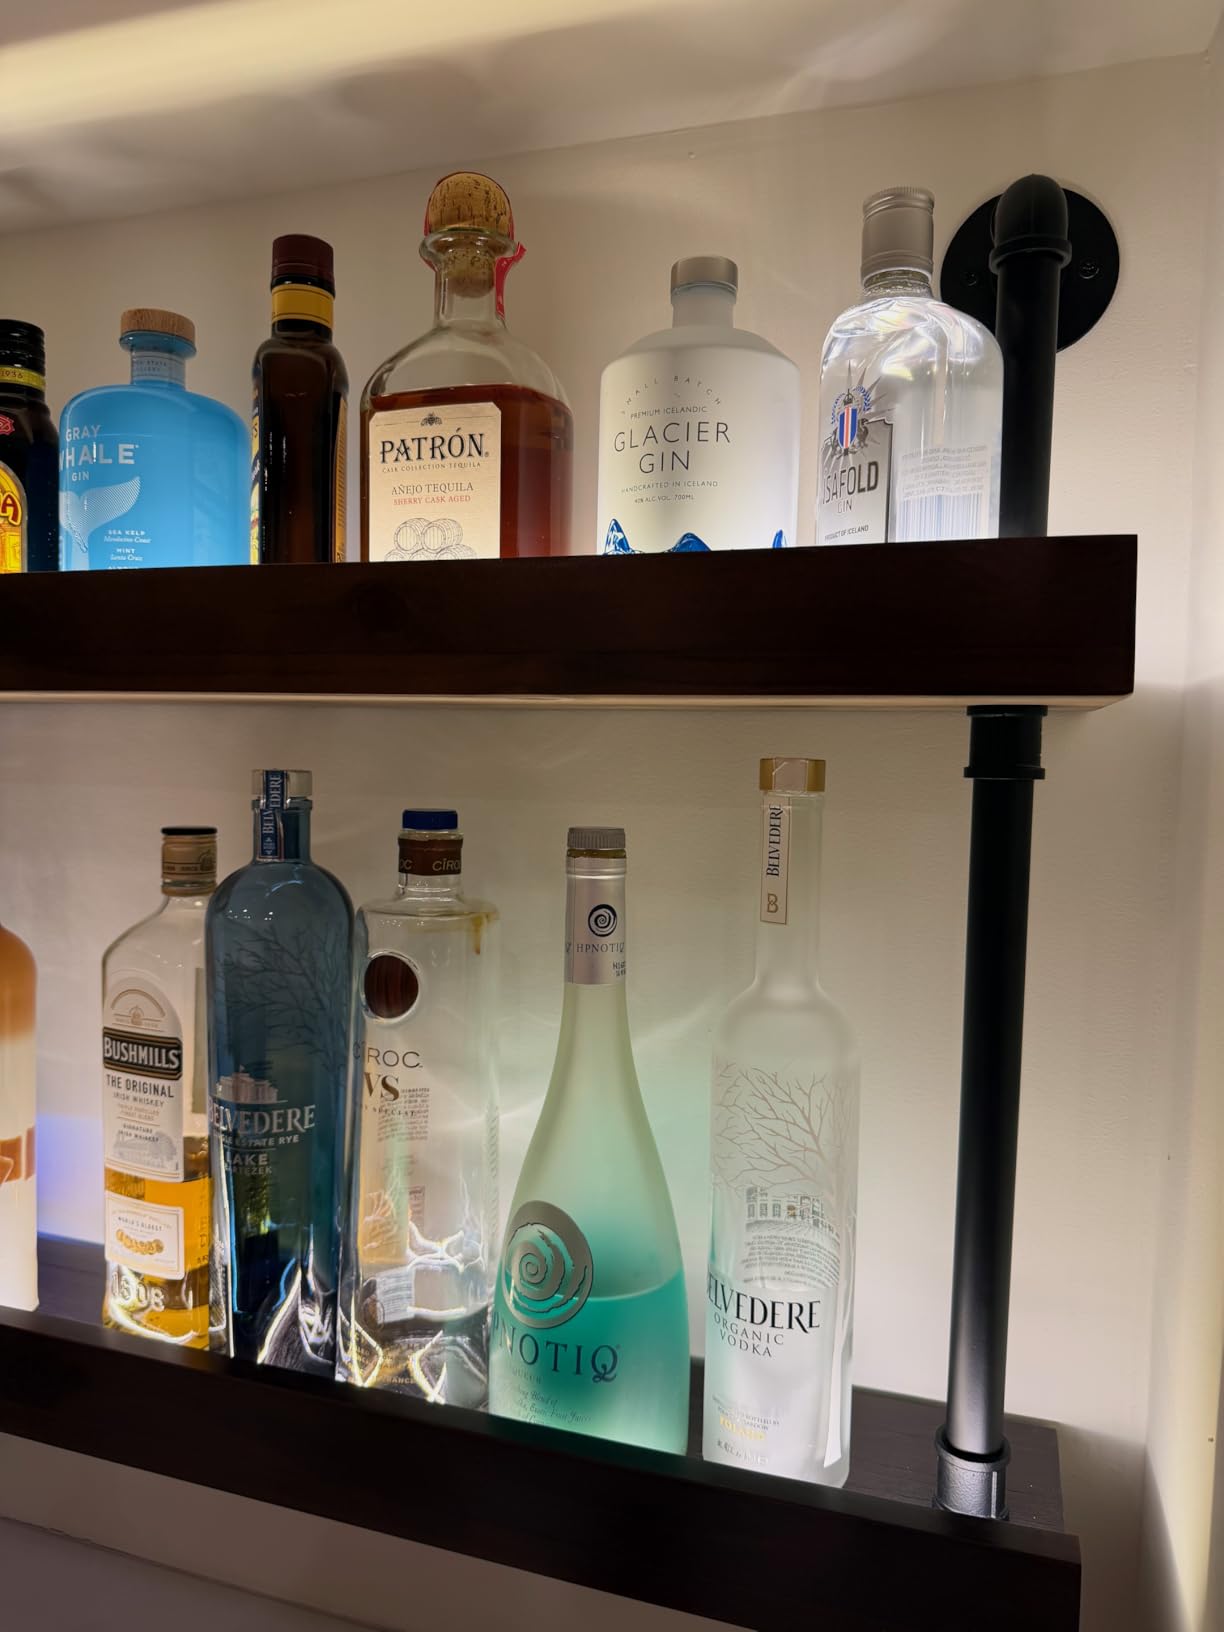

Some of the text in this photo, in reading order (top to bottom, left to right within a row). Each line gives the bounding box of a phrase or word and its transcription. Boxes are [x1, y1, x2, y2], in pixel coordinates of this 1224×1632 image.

[630, 405, 708, 419] PREMIUM ICELANDIC
[65, 424, 101, 442] GRAY
[613, 422, 731, 452] GLACIER
[380, 427, 485, 464] PATRÓN
[449, 461, 481, 470] TEQUILA
[639, 450, 690, 474] GIN
[72, 471, 90, 482] GIN
[683, 480, 718, 488] ICELAND
[391, 482, 474, 496] AÑEJO TEQUILA
[393, 495, 472, 506] SHERRY CASK AGED
[766, 804, 784, 877] BELVEDERE
[103, 1036, 181, 1070] BUSHMILLS
[106, 1074, 175, 1098] THE ORIGINAL
[132, 1094, 164, 1108] WHISKEY
[278, 1134, 300, 1145] RYE
[713, 1311, 785, 1346] ORGANIC
[719, 1328, 773, 1358] VODKA
